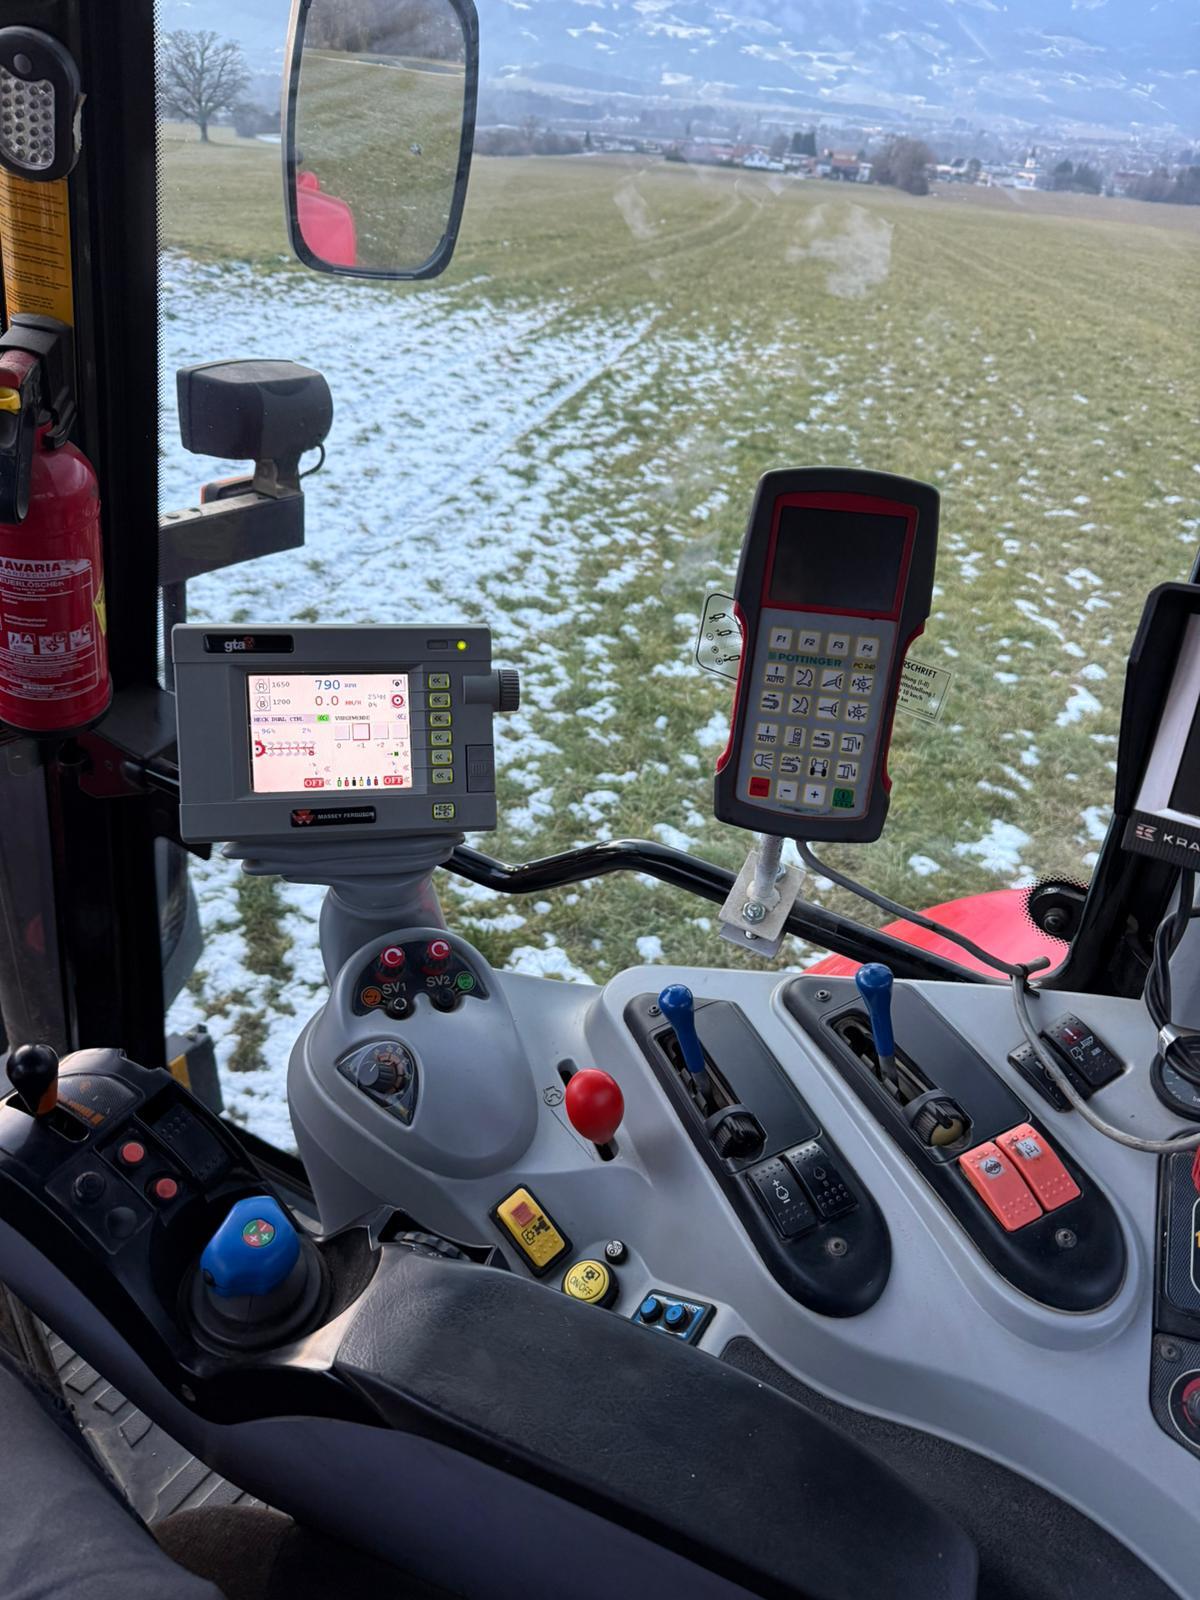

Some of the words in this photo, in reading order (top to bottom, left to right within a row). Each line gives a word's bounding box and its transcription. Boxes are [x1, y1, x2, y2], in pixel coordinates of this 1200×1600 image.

[776, 635, 787, 643] F1
[804, 638, 816, 646] F2
[832, 641, 845, 649] F3
[862, 644, 873, 652] F4
[315, 679, 341, 690] 790
[767, 676, 785, 684] AUTO
[315, 695, 340, 706] 0.0
[757, 735, 776, 743] AUTO
[304, 779, 324, 788] OFF
[384, 776, 403, 785] OFF
[426, 975, 451, 988] SV2
[382, 982, 407, 995] SV1
[569, 1275, 594, 1297] ON/OFF
